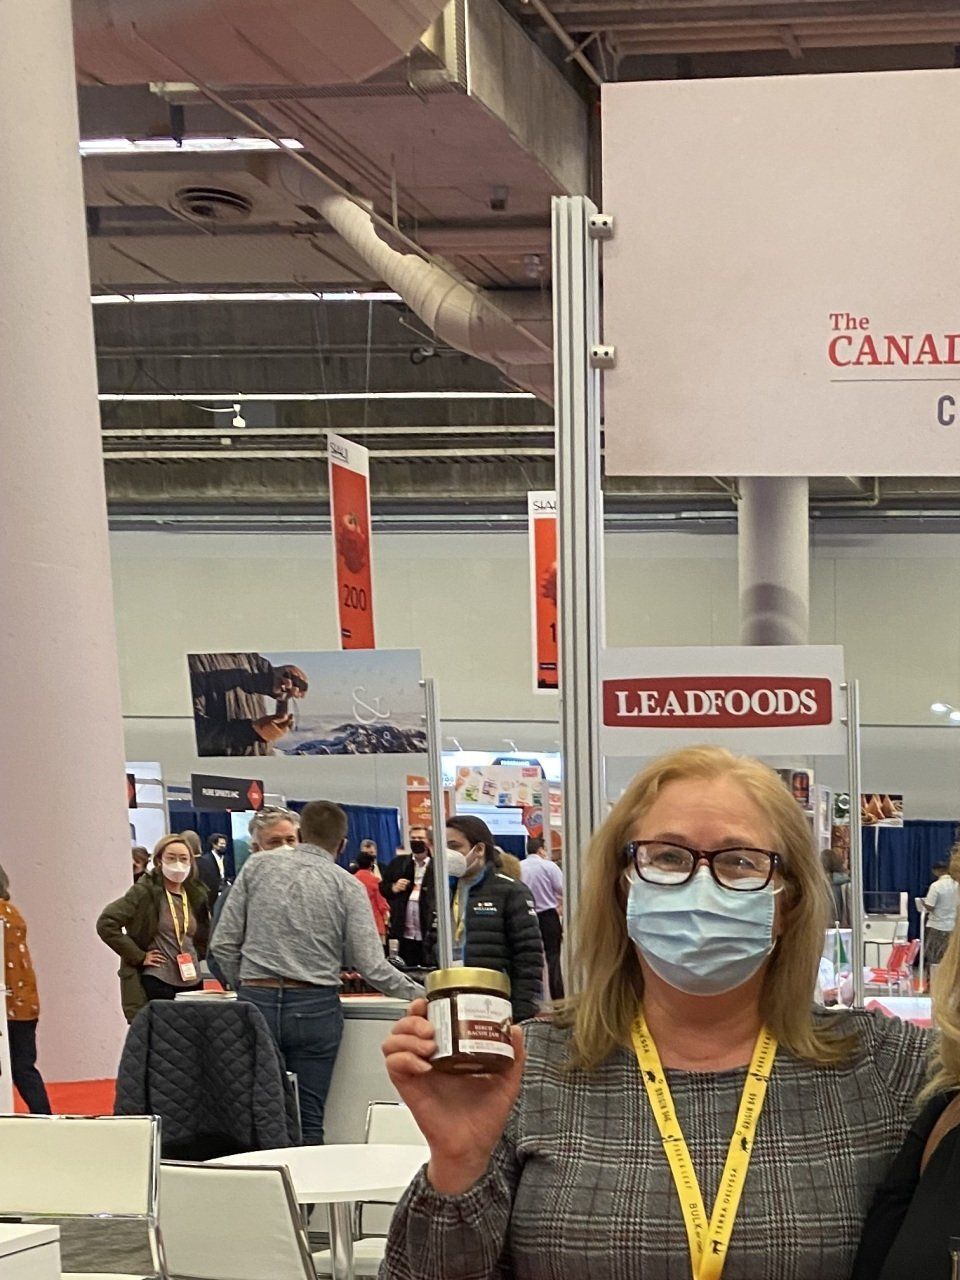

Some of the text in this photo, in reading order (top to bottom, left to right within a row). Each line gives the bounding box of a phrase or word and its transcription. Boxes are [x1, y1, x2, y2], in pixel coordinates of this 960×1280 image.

[829, 313, 870, 331] The
[343, 584, 367, 612] 200
[615, 689, 818, 717] LEADFOODS
[688, 1202, 702, 1230] BULK
[714, 1205, 728, 1235] TERRA
